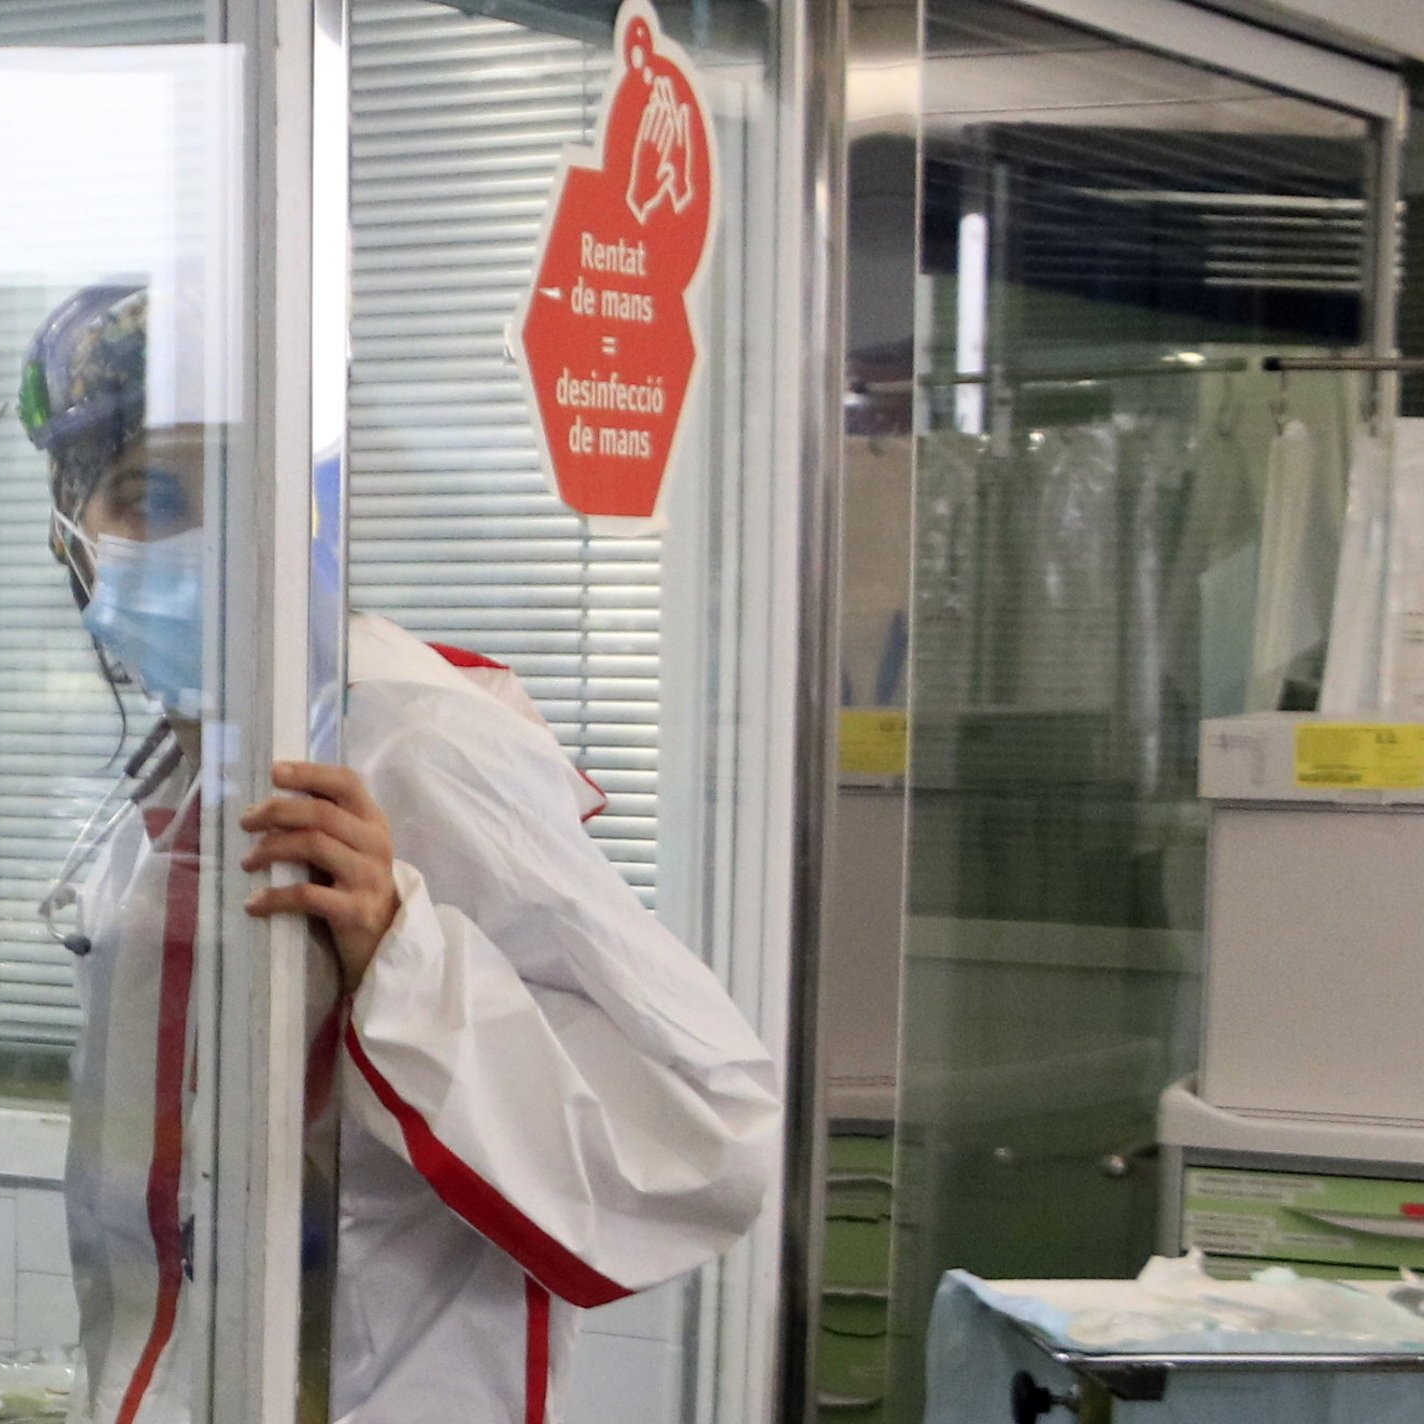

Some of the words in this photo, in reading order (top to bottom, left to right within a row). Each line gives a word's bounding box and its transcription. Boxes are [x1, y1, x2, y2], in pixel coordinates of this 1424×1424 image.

[580, 231, 646, 276] Rentat
[570, 275, 595, 315] de
[600, 289, 653, 324] mans
[555, 366, 664, 413] desinfecció
[568, 414, 593, 452] de
[599, 427, 651, 457] mans
